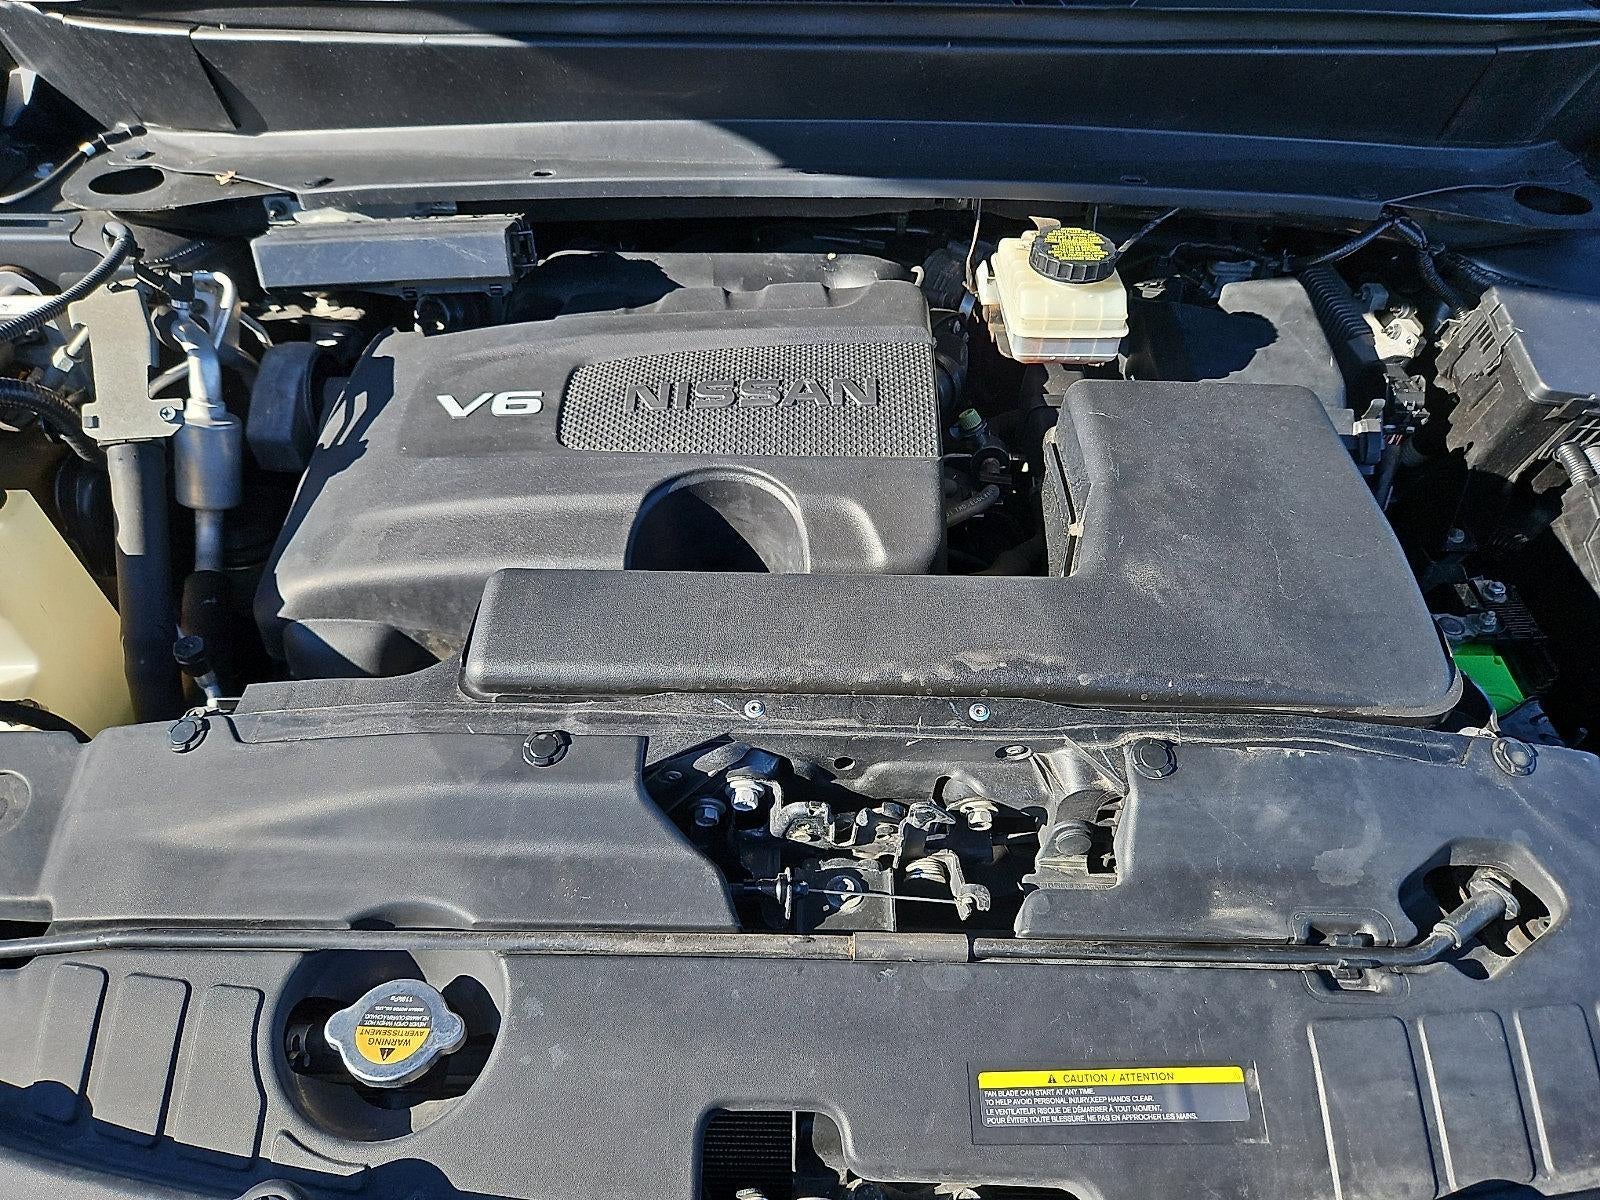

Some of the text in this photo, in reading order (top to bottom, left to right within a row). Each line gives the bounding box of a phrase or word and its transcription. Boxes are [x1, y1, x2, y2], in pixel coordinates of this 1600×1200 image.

[624, 376, 879, 413] NISSAN
[436, 390, 544, 420] V6
[359, 1028, 425, 1037] AVERTISSEMENT
[368, 1037, 411, 1047] WARNING
[1063, 1073, 1108, 1083] CAUTION
[1119, 1072, 1174, 1082] ATTENTION
[984, 1089, 997, 1097] FAN
[998, 1089, 1019, 1097] BLADE
[1035, 1088, 1055, 1096] START
[1079, 1087, 1095, 1095] TIME.
[1033, 1097, 1068, 1105] PERSONAL
[1108, 1095, 1131, 1103] HANDS
[986, 1108, 994, 1116] LE
[994, 1107, 1036, 1116] VENTILATEUR
[1037, 1107, 1062, 1115] RISQUE
[1072, 1105, 1108, 1113] DÉMARRER
[1108, 1104, 1114, 1113] À
[1132, 1104, 1162, 1112] MOMENT.
[1006, 1115, 1028, 1124] ÉVITER
[1051, 1115, 1086, 1123] BLESSURE,
[1121, 1113, 1161, 1121] APPROCHER
[1176, 1112, 1198, 1120] MAINS.
